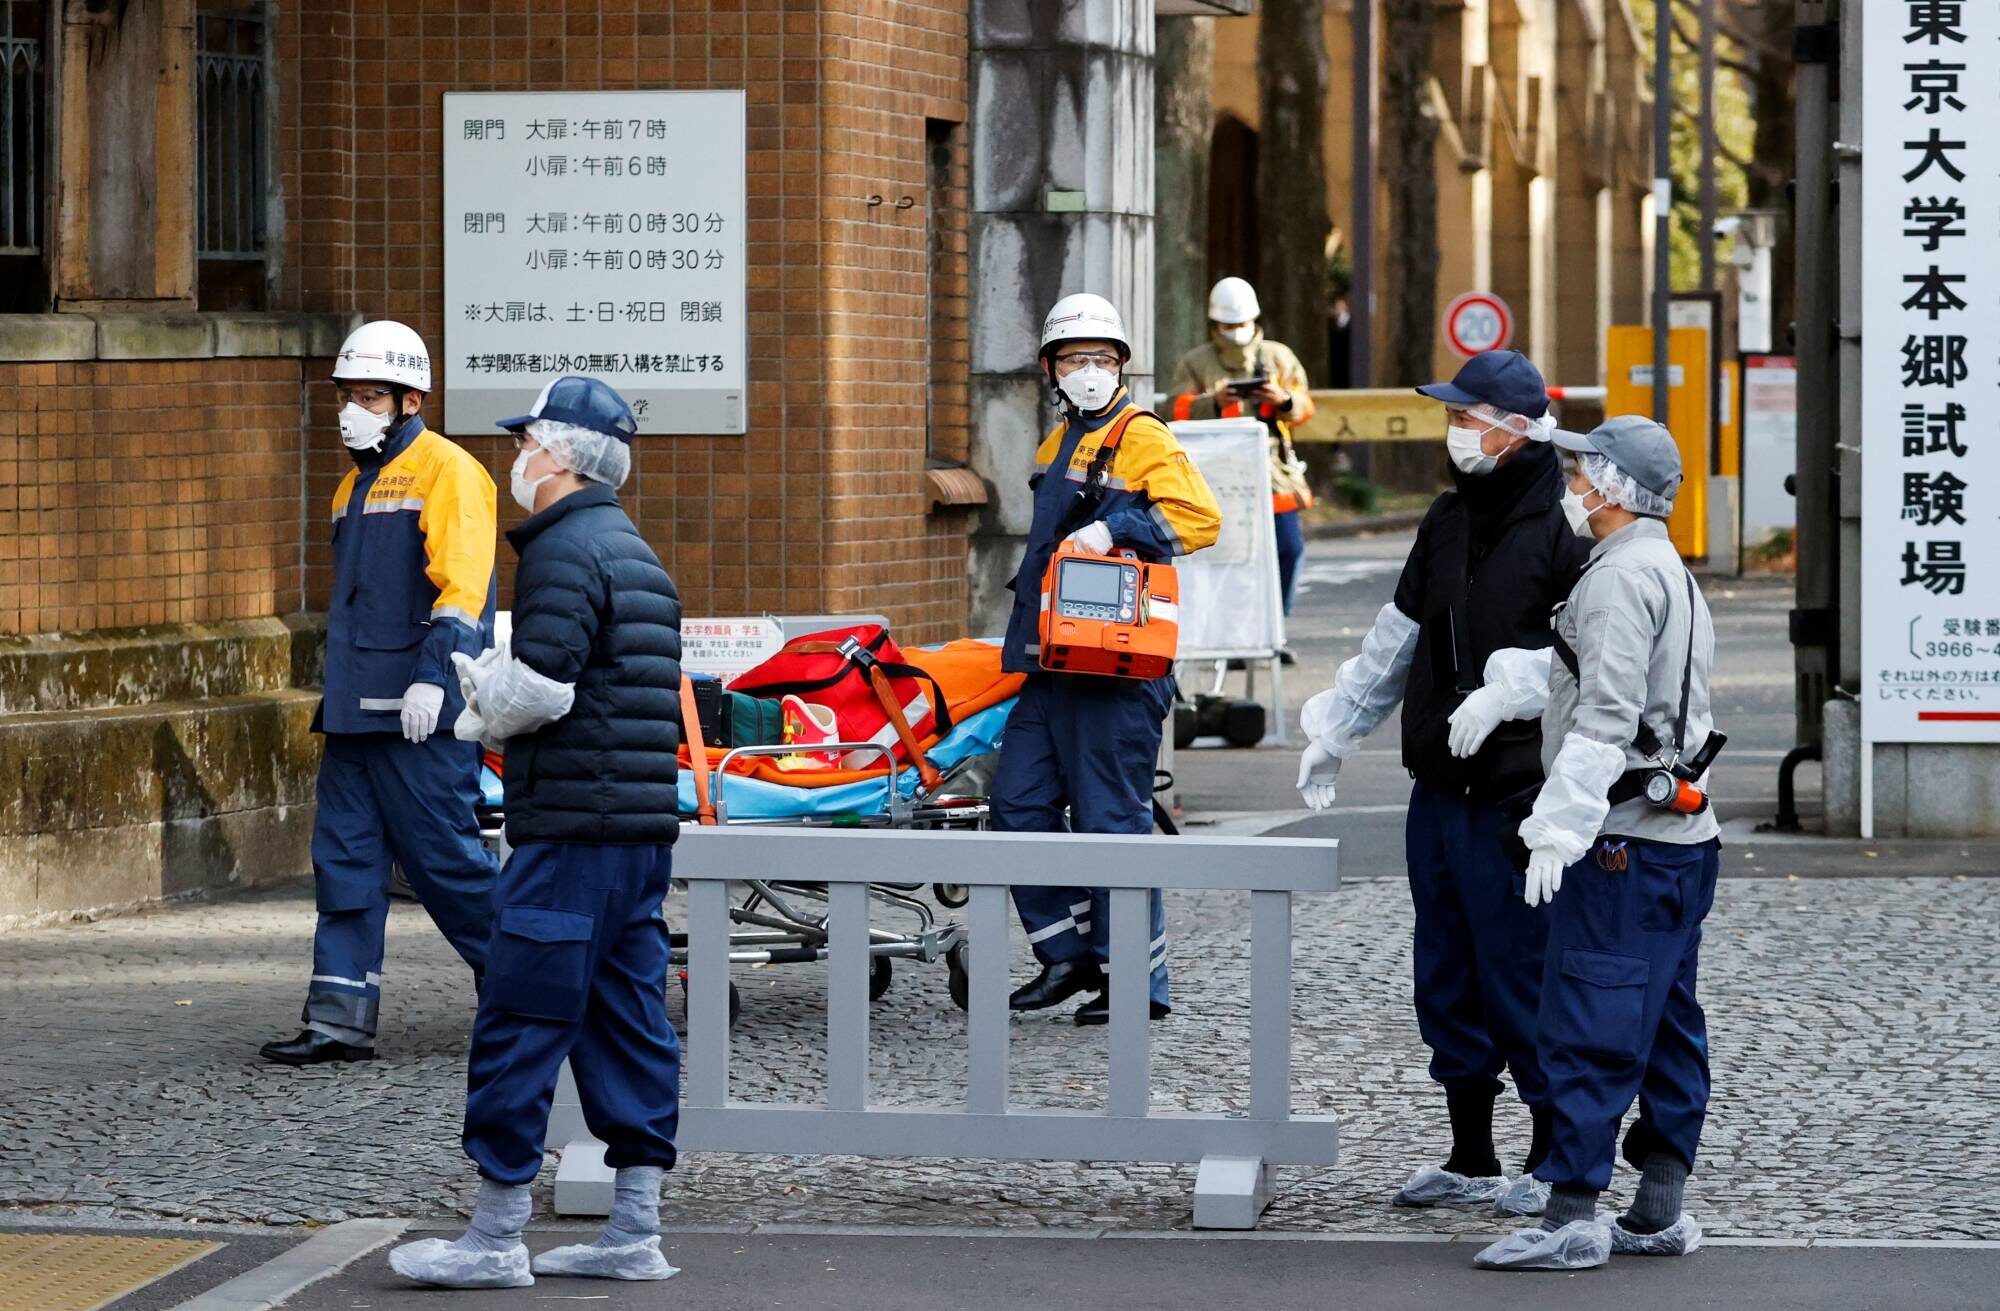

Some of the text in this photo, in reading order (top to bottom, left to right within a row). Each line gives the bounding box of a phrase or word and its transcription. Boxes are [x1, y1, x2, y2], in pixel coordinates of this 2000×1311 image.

[463, 118, 667, 141] 開門 大扉：午前7時
[525, 154, 667, 177] 小扉：午前6時
[463, 212, 506, 234] 閉門
[1899, 0, 1969, 597] 東京大学本郷試験場
[680, 301, 723, 323] 閉鎖
[1462, 310, 1498, 341] 20
[465, 352, 725, 374] 本学関係者以外の無断入構を禁止する
[1879, 687, 1980, 700] してください。
